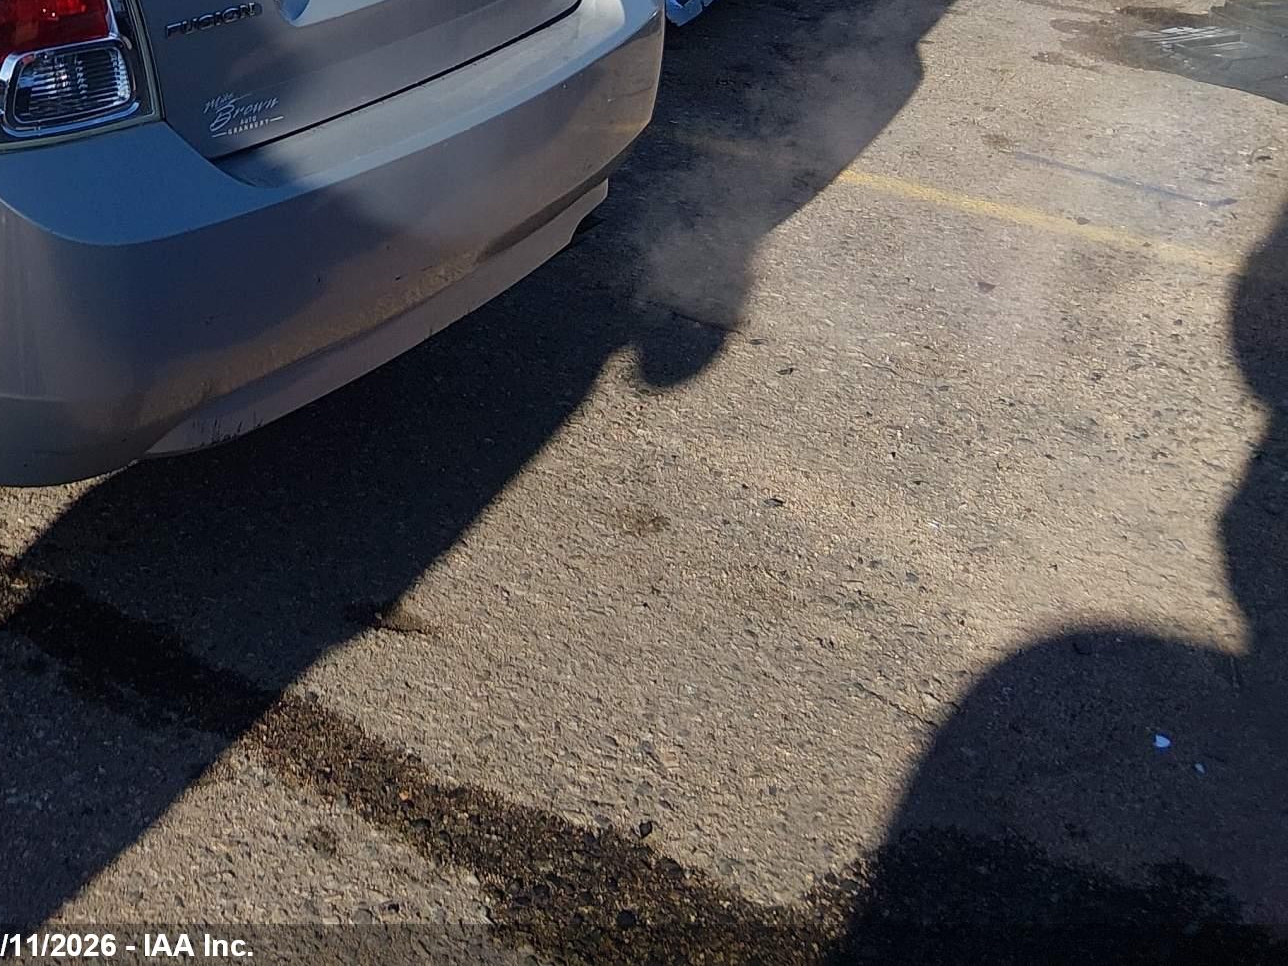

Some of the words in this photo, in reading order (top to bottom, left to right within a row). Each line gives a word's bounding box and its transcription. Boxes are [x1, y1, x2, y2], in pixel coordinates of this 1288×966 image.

[165, 2, 258, 40] FUSION
[210, 95, 280, 132] Brown
[227, 118, 270, 135] GRANBURY
[240, 115, 258, 125] AUTO
